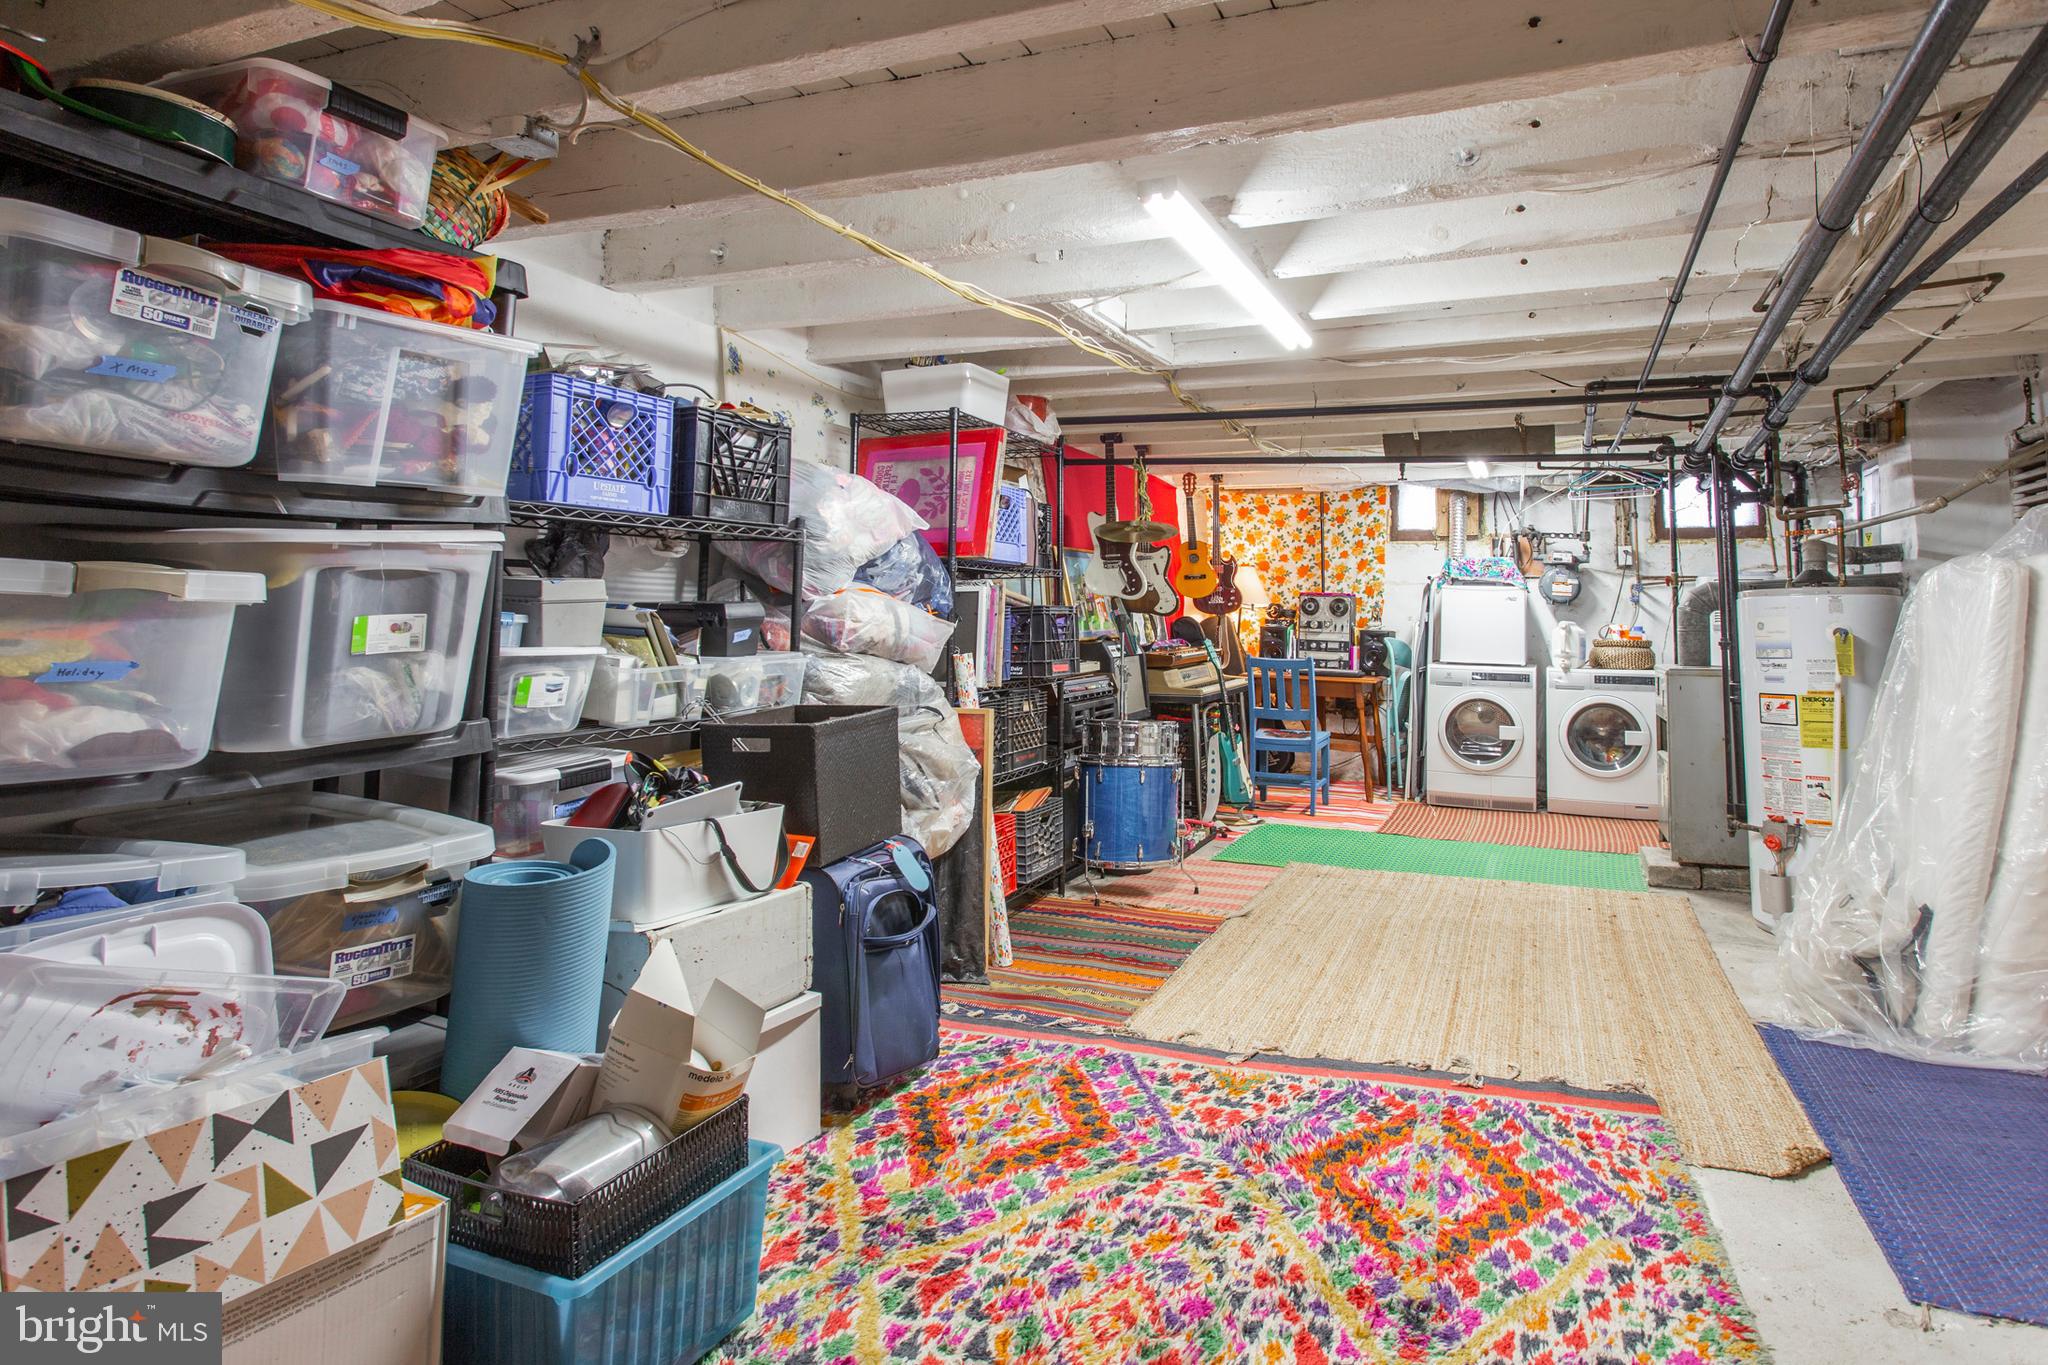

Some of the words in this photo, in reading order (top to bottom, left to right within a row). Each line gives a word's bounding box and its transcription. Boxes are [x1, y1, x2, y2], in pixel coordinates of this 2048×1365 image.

[142, 307, 163, 322] 50
[164, 313, 186, 324] QUART
[230, 304, 279, 326] EXTREMELY
[234, 315, 274, 332] DURABLE
[56, 667, 104, 680] Holiday
[353, 973, 369, 985] 50
[688, 1070, 724, 1083] medela
